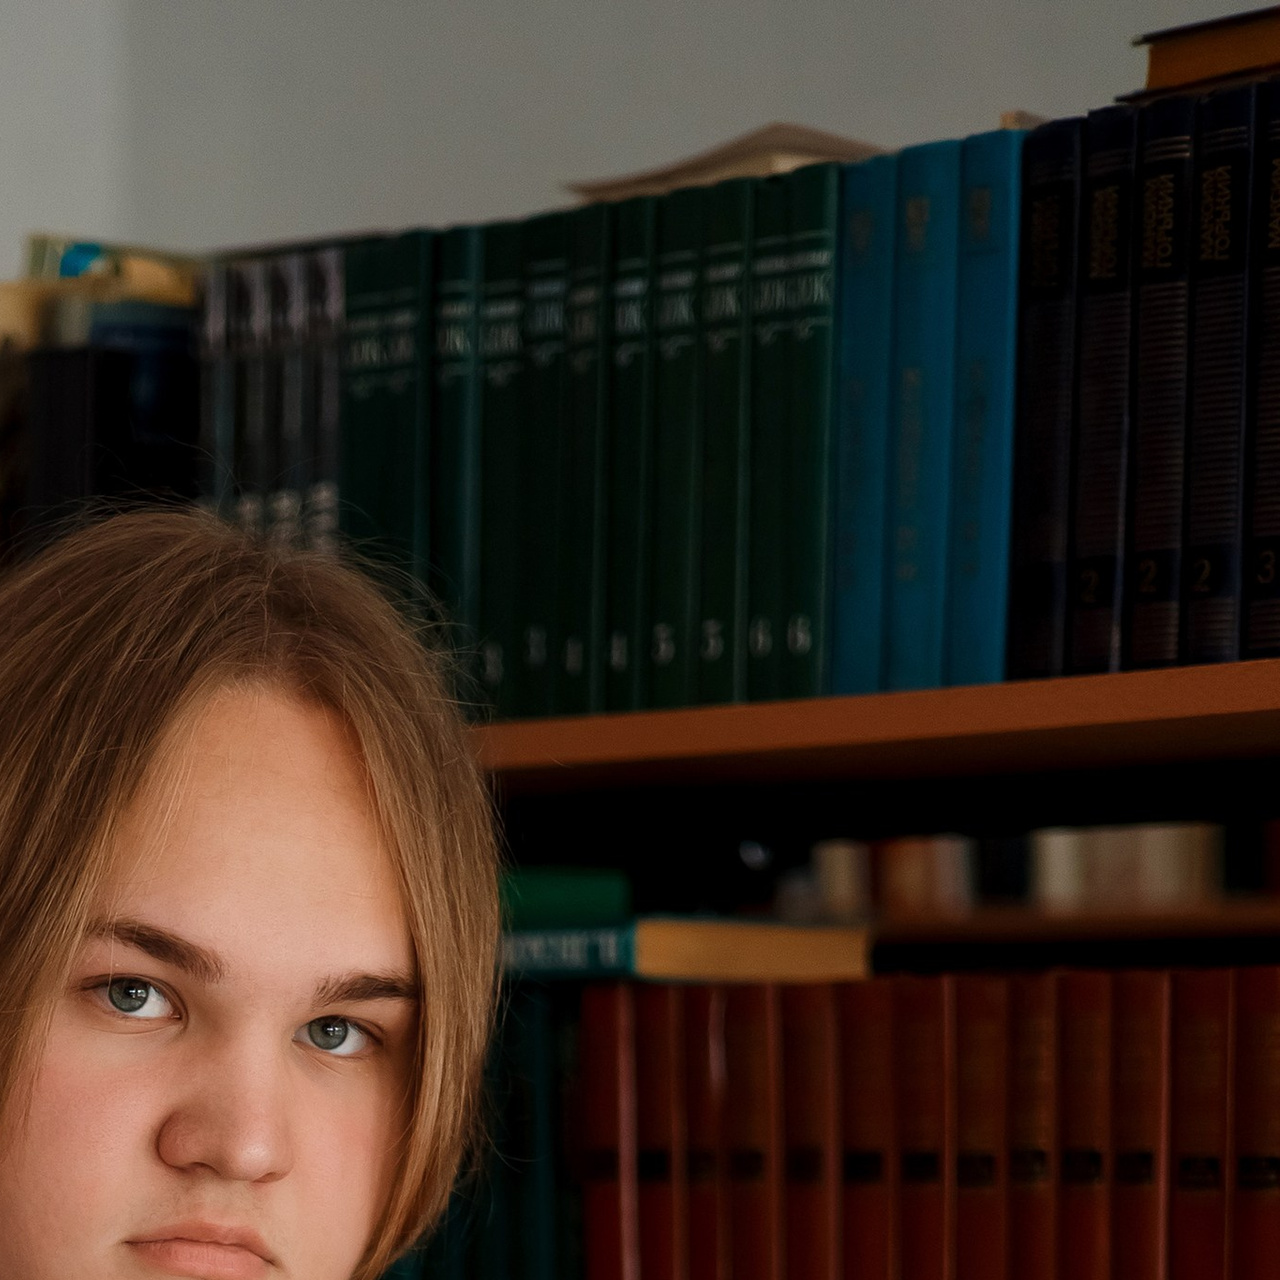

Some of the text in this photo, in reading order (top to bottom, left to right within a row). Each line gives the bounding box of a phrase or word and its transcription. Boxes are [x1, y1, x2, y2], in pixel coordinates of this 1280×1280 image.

[1156, 173, 1175, 268] ГОРЬКИЙ
[1199, 170, 1215, 262] МАКСИМ
[1214, 164, 1232, 260] ГОРЬКИЙ
[1137, 557, 1159, 595] 2
[1189, 556, 1213, 593] 2
[1256, 548, 1277, 585] 3
[1079, 568, 1101, 604] 2
